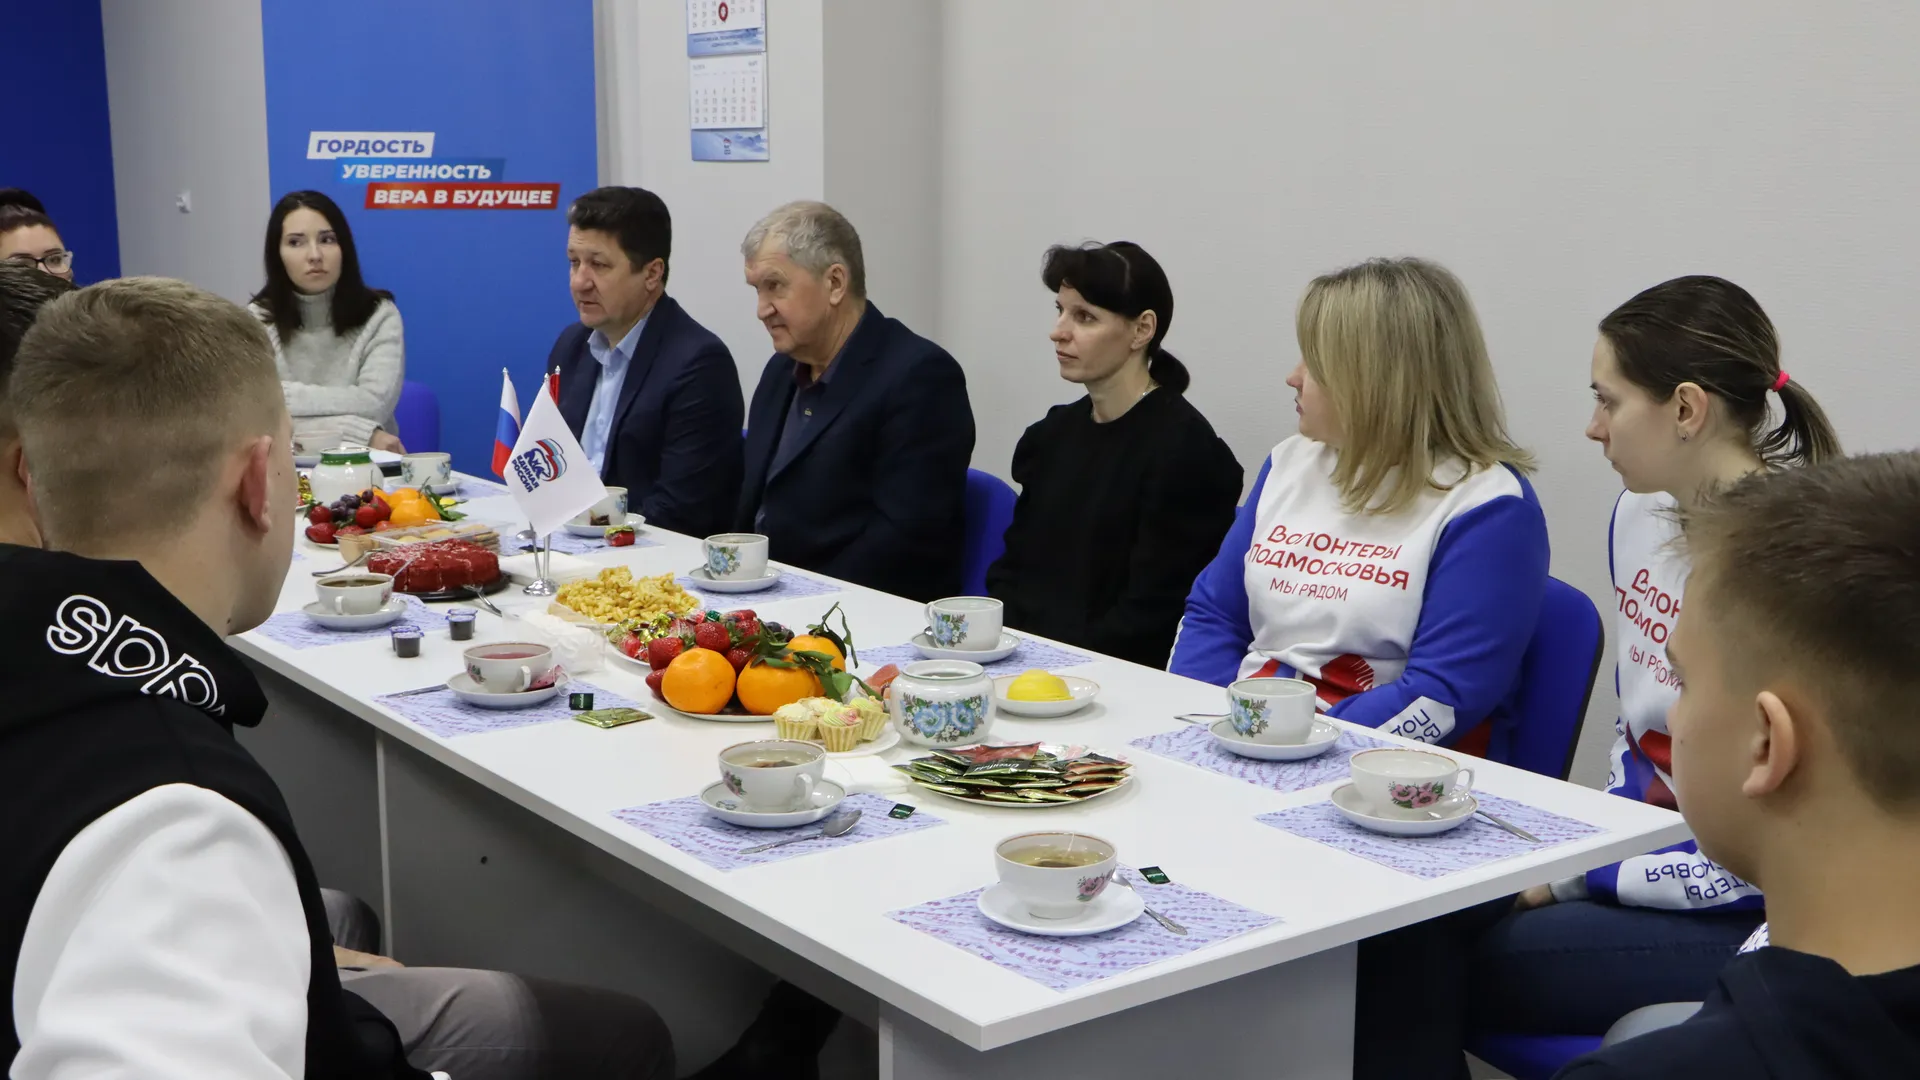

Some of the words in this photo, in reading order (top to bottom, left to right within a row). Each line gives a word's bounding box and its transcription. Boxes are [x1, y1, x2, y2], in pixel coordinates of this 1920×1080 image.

[316, 139, 425, 155] ГОРДОСТЬ
[341, 164, 492, 180] УВЕРЕННОСТЬ
[373, 189, 428, 205] ВЕРА
[433, 189, 448, 204] В
[453, 189, 553, 207] БУДУЩЕЕ
[511, 459, 534, 493] РОССИЯ
[516, 454, 540, 489] ЕДИНАЯ
[1267, 524, 1403, 560] ВОЛОНТЕРЫ
[1248, 543, 1410, 590] ПОДМОСКОВЬЯ
[1269, 577, 1299, 594] МЫ
[1298, 583, 1349, 601] РЯДОМ
